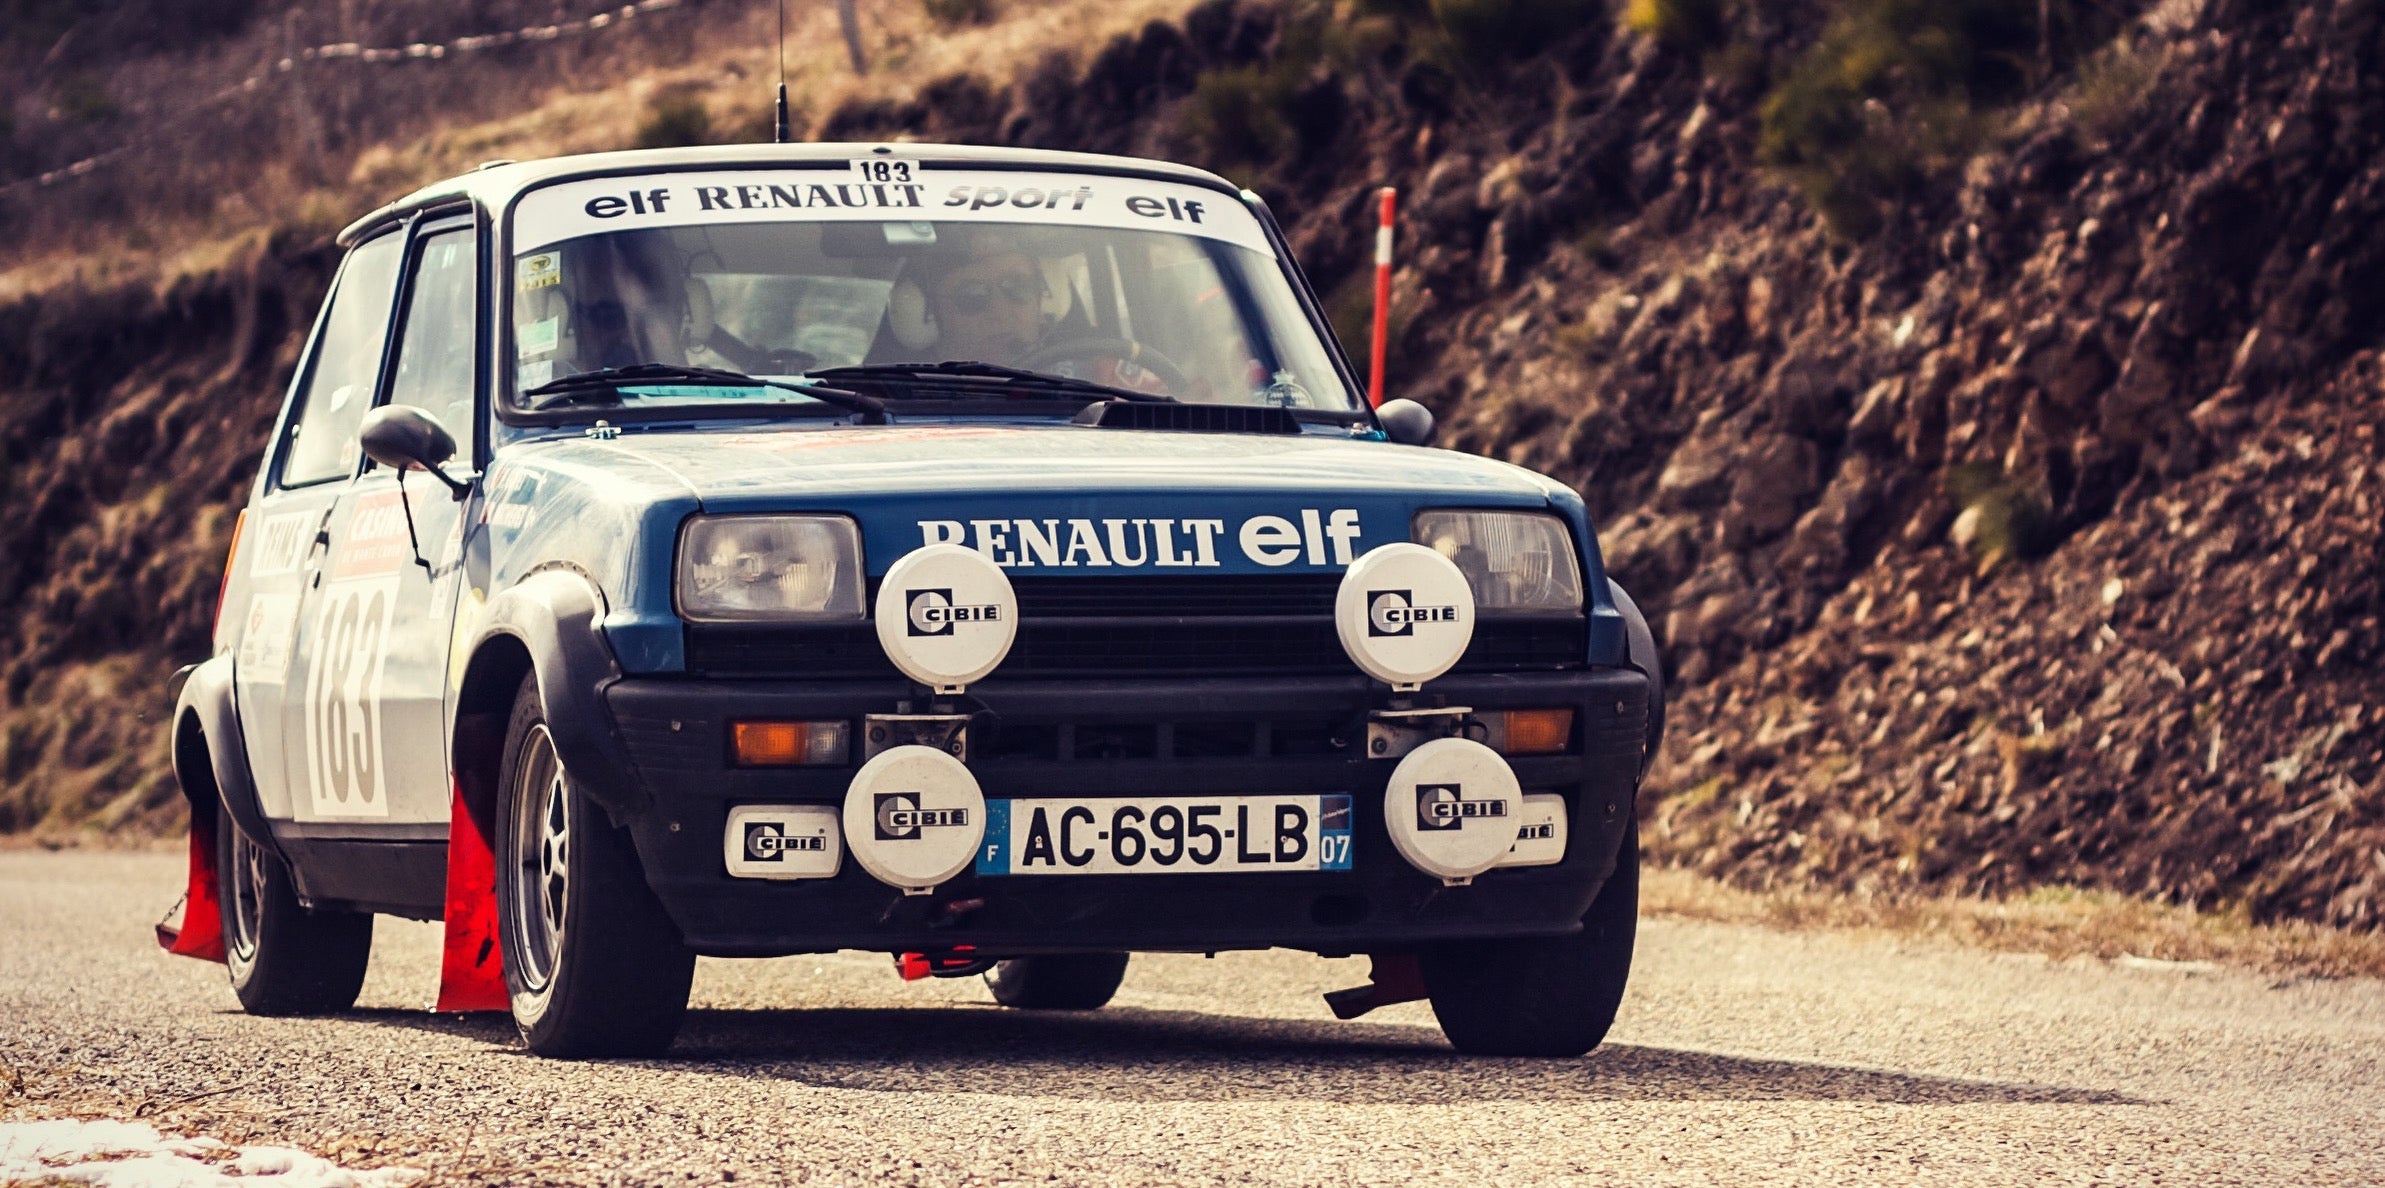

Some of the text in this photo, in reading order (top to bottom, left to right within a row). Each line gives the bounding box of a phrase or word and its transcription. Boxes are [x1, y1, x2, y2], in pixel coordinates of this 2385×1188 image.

[860, 161, 911, 182] 183
[584, 184, 1206, 224] elf RENAULT sport elf
[1239, 508, 1362, 566] elf
[314, 589, 385, 804] 183
[987, 804, 1350, 867] F AC-695-LB 07
